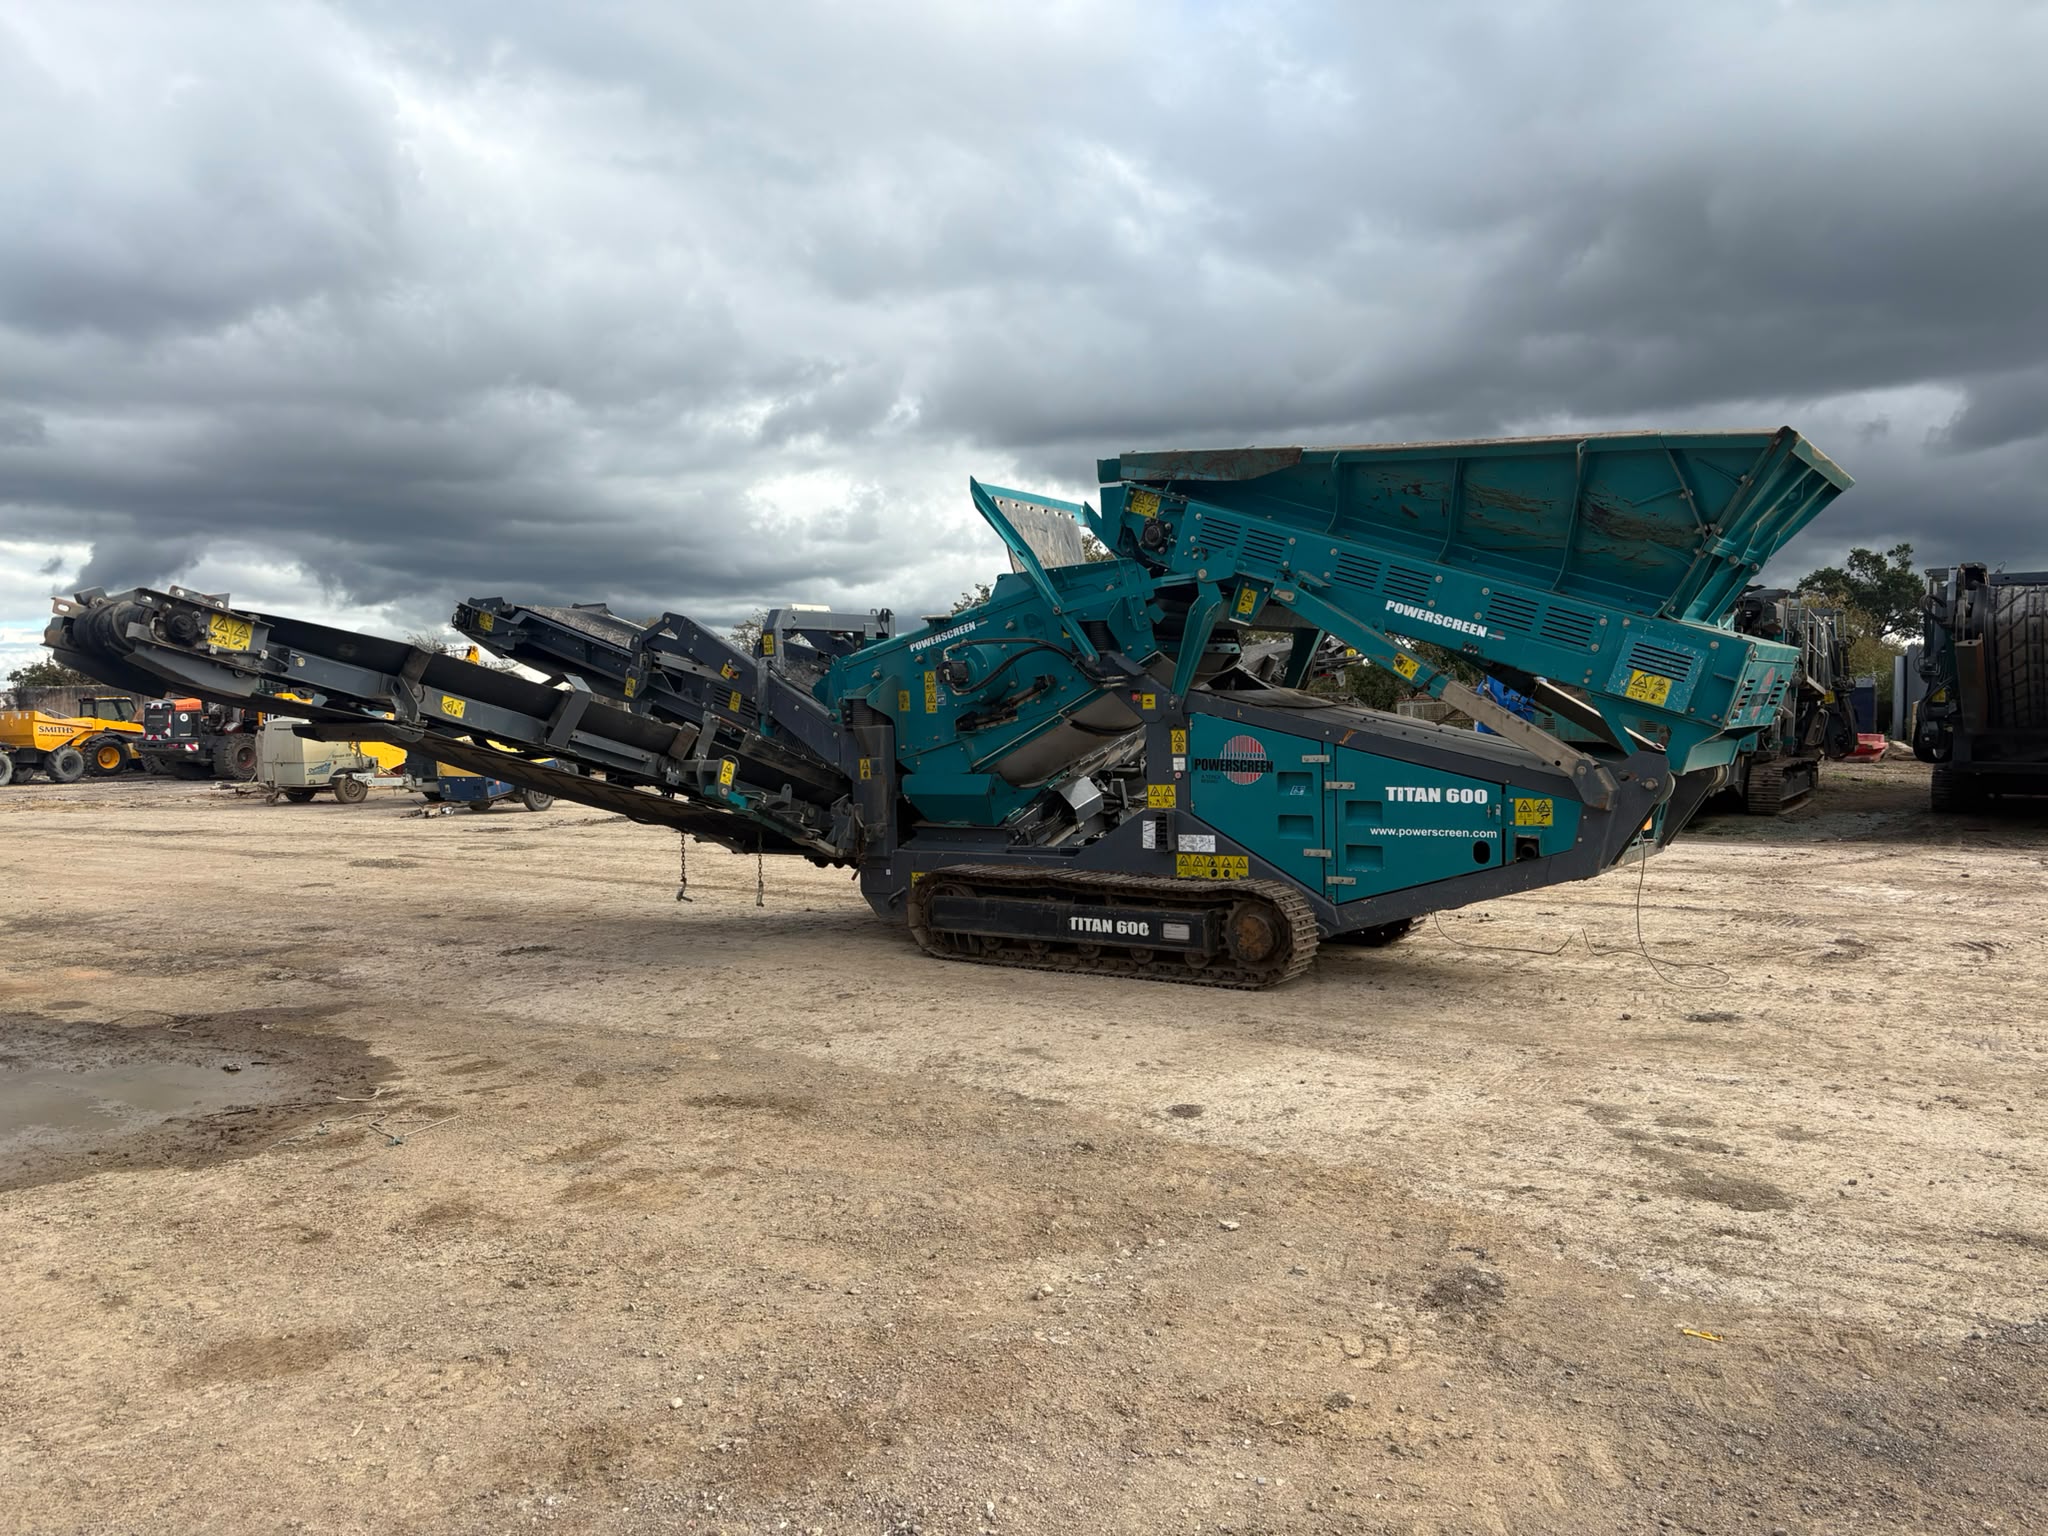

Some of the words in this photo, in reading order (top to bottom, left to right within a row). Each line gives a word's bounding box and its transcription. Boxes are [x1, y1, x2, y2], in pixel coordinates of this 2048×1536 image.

[1385, 600, 1488, 638] POWERSCREEN
[909, 621, 977, 653] POWERSCREEN
[38, 725, 75, 734] SMITHS
[1194, 758, 1274, 774] POWERSCREEN
[1385, 786, 1441, 803] TITAN
[1446, 788, 1488, 805] 600
[1370, 827, 1498, 838] www.powerscreen.com
[1070, 916, 1113, 934] TITAN
